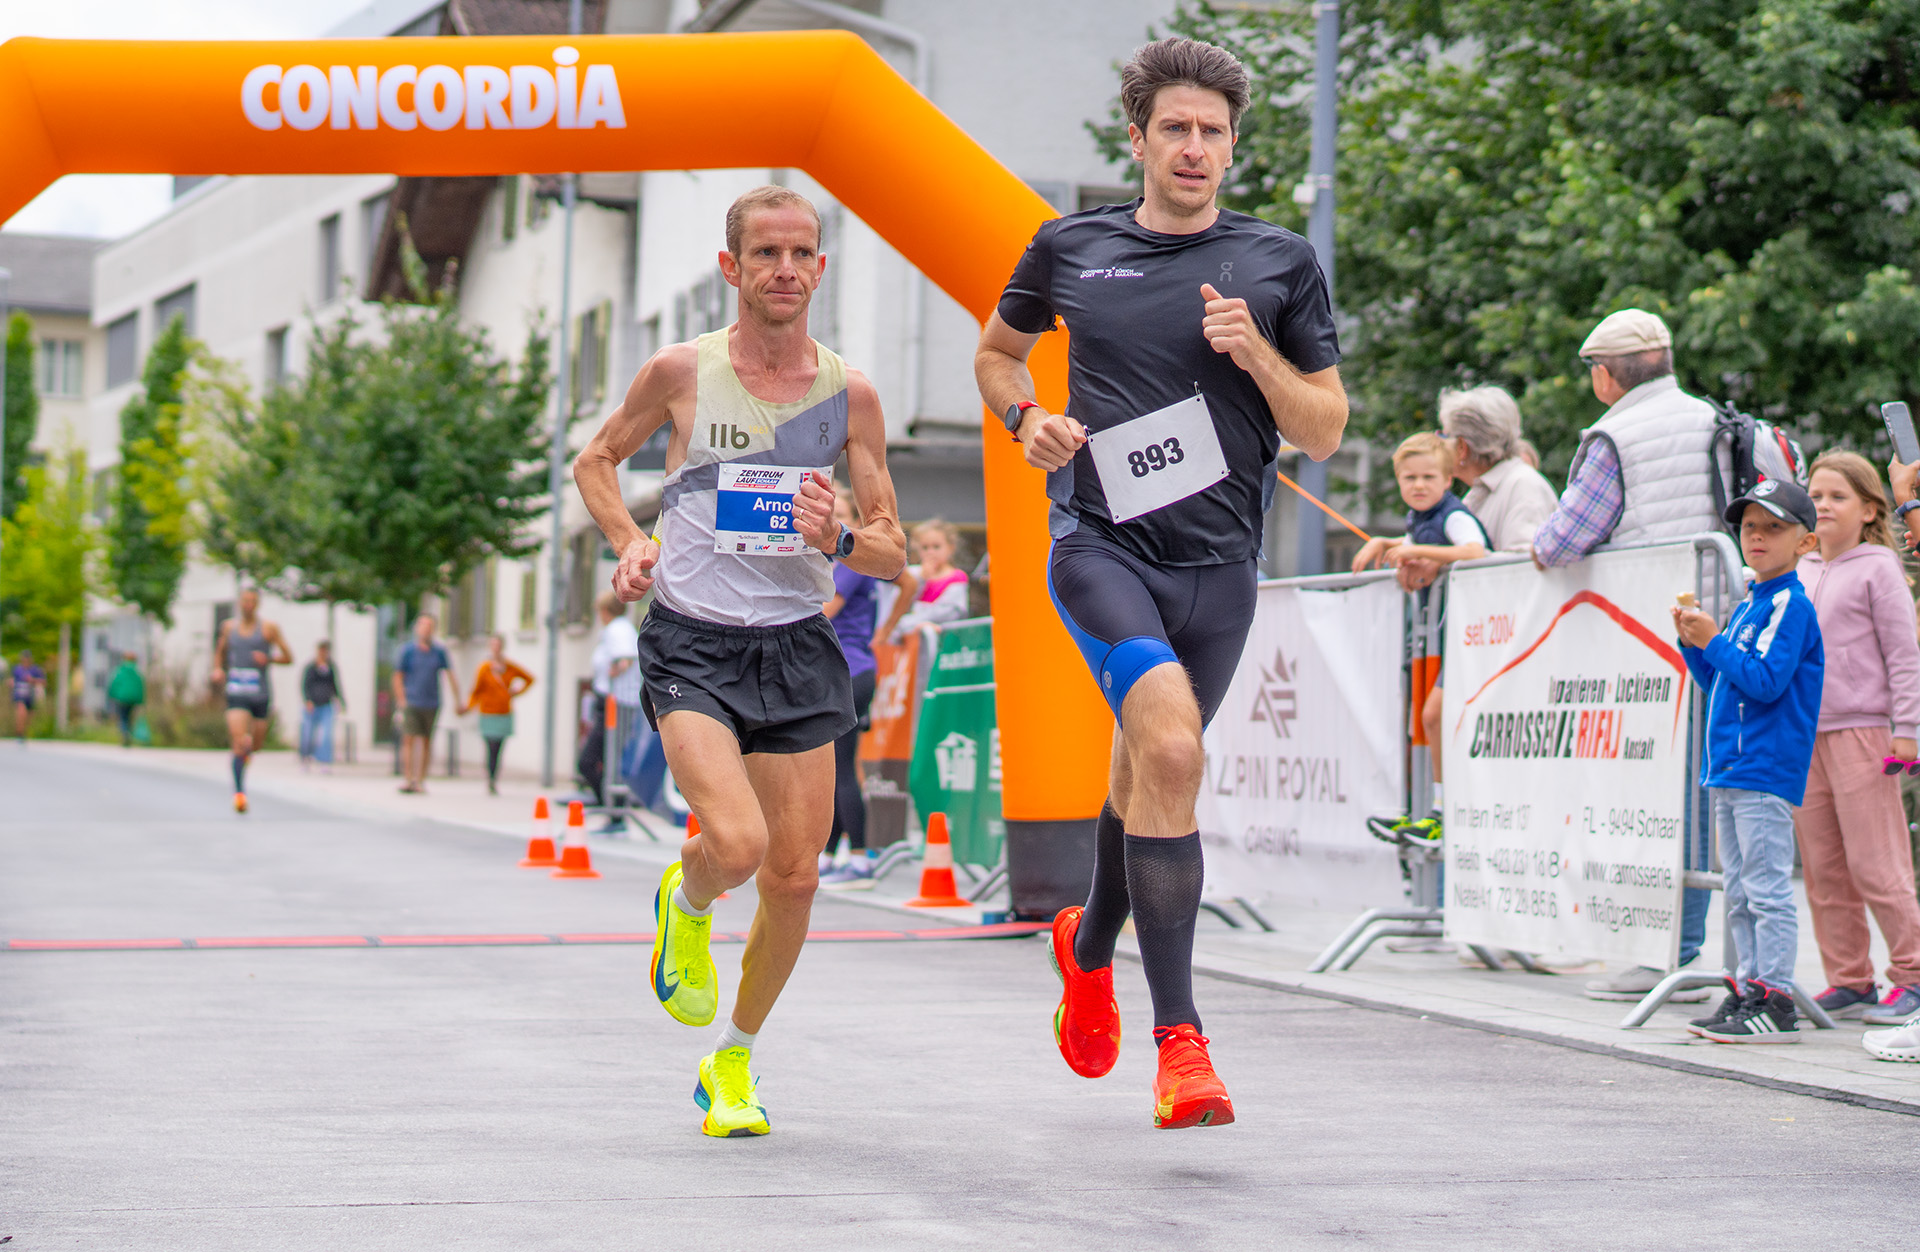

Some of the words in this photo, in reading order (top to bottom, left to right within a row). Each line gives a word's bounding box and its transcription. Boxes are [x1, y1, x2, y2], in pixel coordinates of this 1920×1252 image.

[748, 425, 769, 435] 1861
[1127, 436, 1184, 478] 893
[735, 476, 757, 484] LAUF
[739, 469, 784, 479] ZENTRUM
[769, 515, 788, 529] 62
[1277, 756, 1347, 804] ROYAL
